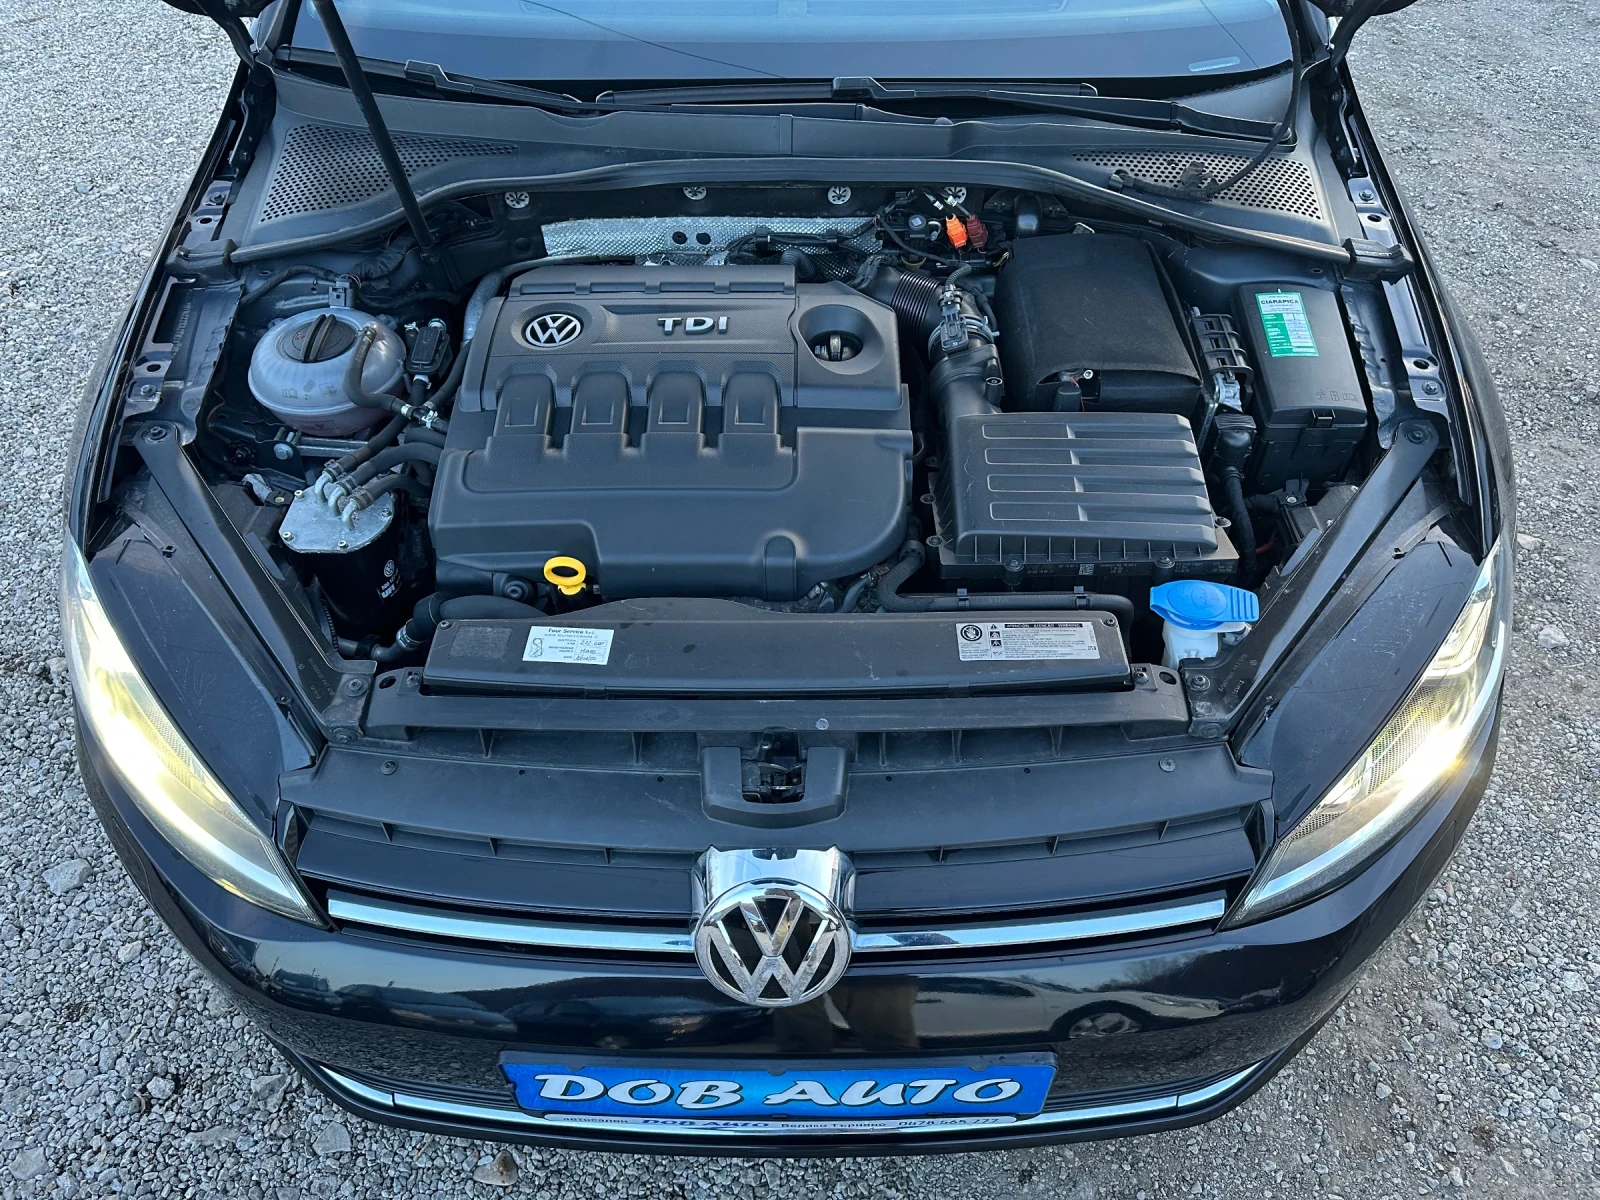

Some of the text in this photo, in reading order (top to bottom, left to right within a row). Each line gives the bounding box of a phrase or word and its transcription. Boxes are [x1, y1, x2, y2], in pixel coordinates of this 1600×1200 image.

[657, 316, 729, 336] TDI
[695, 877, 851, 1007] VW
[534, 1074, 1022, 1110] DOB AUTO
[641, 1119, 696, 1127] DOB
